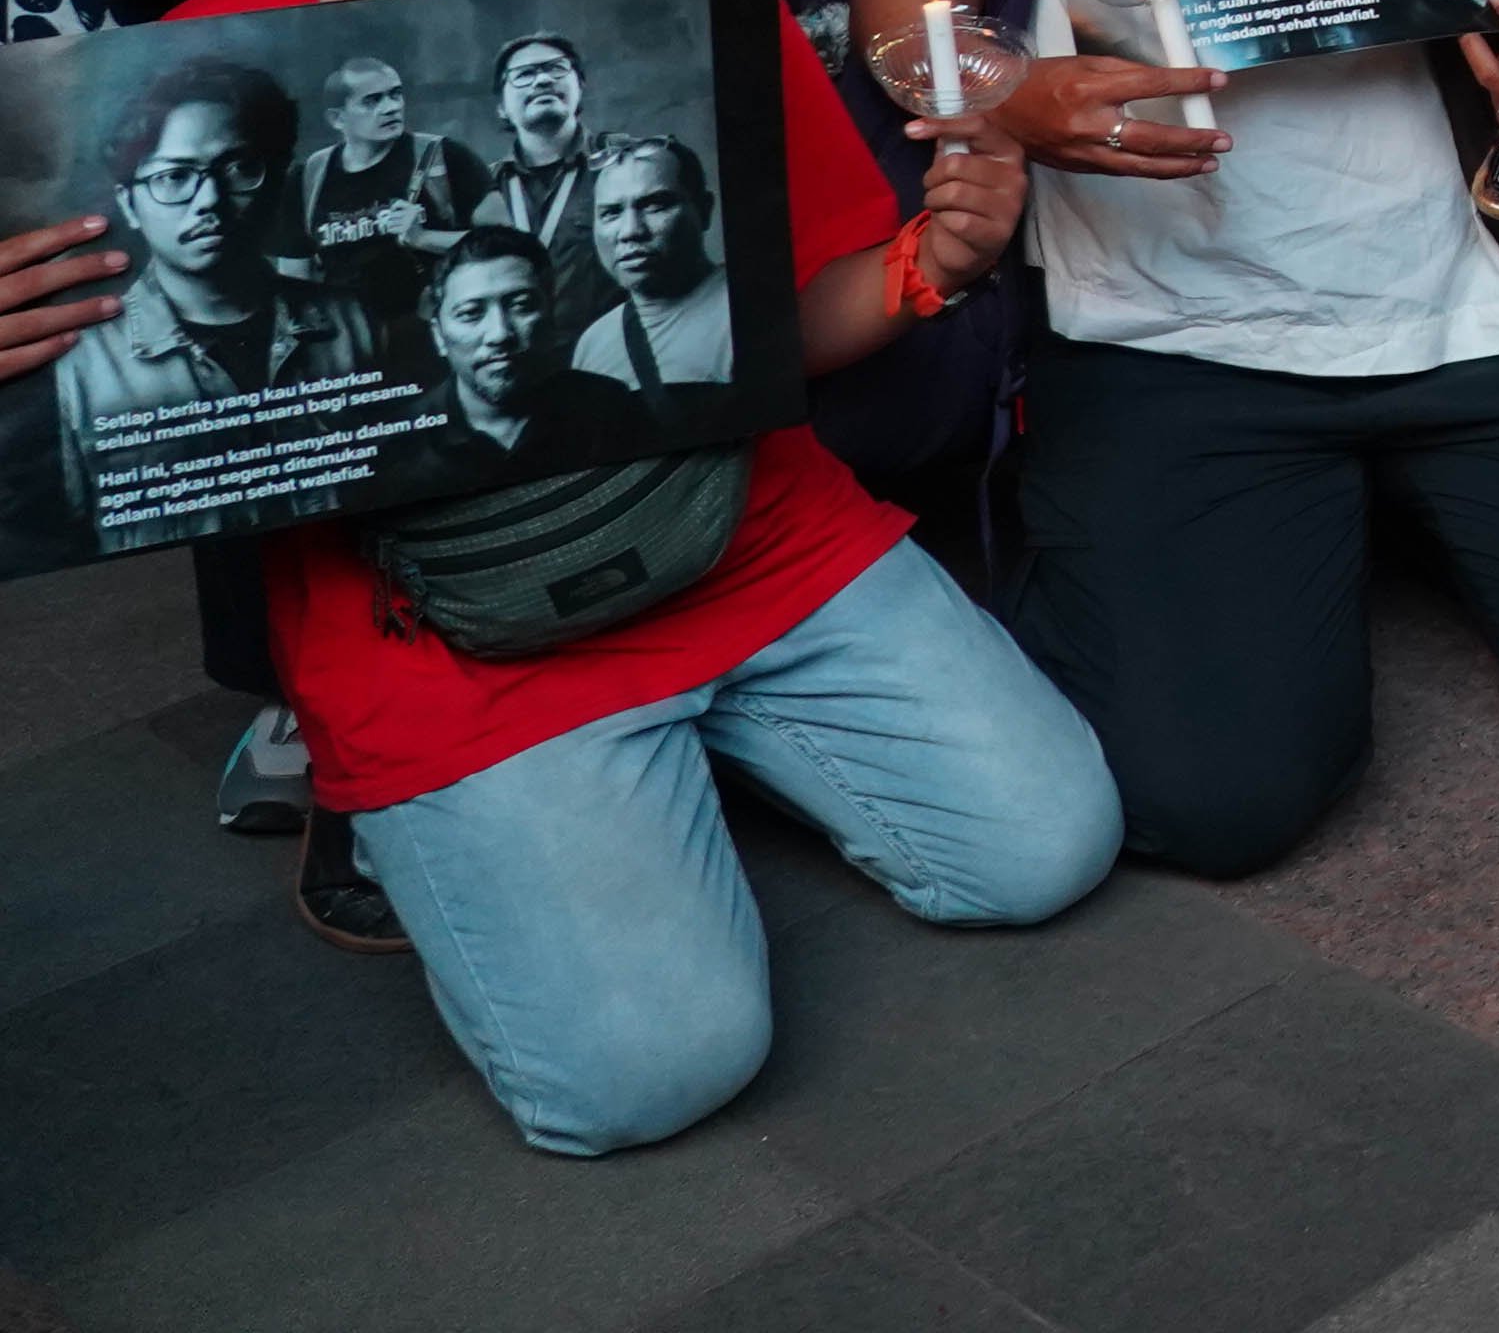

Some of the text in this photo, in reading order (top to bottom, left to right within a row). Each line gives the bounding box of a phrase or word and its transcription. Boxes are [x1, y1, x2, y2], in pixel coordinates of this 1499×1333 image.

[94, 369, 382, 432] Setiap berita yang kau kabarkan
[96, 383, 423, 452] selalu membawa suara bagi sesama.
[99, 411, 448, 488] Hari ini, suara kami menyatu dalam doa
[100, 443, 378, 510] agar engkau segera ditemukan
[101, 464, 375, 529] dalam keadaan sehat walafiat.
